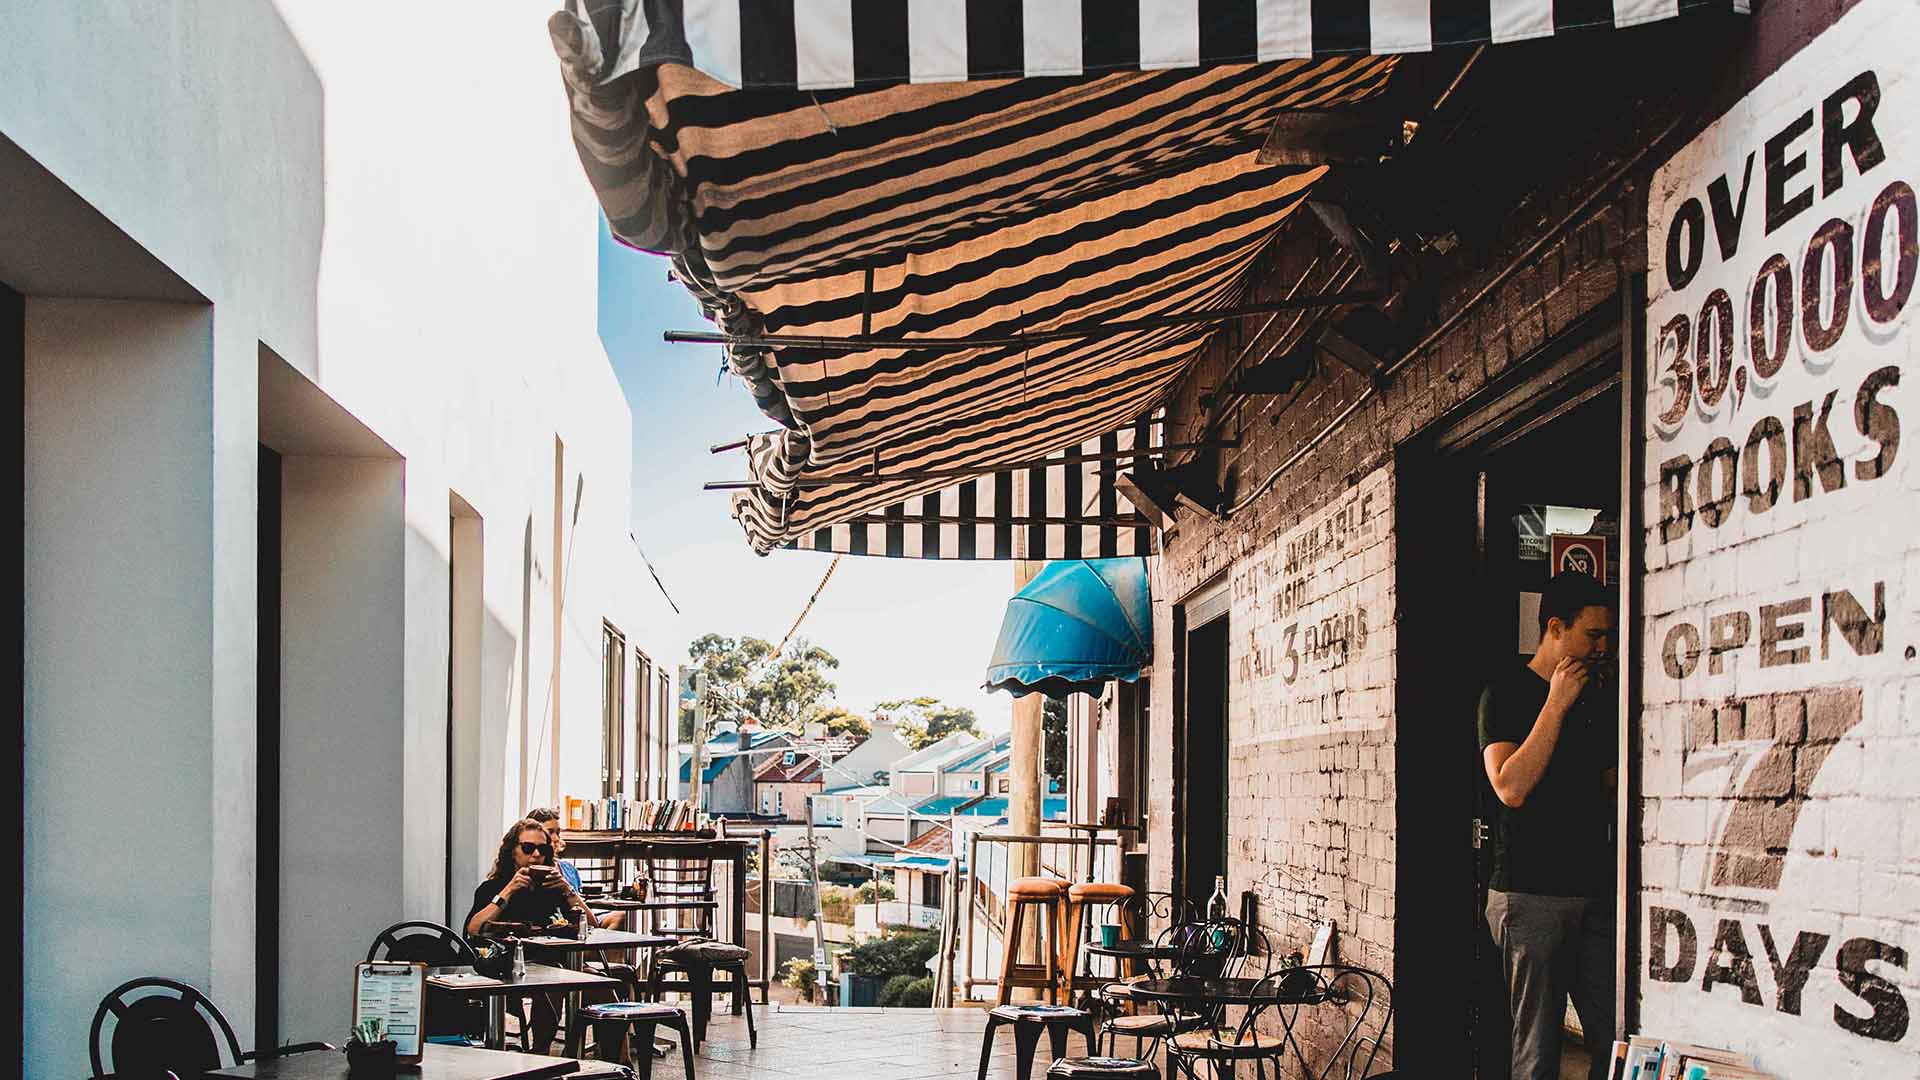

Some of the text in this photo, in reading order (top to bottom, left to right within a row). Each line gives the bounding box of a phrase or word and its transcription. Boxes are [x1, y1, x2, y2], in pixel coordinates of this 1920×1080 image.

[1665, 69, 1886, 291] OVER
[1656, 180, 1919, 428] 30,000
[1658, 365, 1900, 546] BOOKS
[1281, 622, 1299, 686] 3
[1661, 581, 1886, 680] OPEN
[1691, 686, 1864, 891] 7
[1648, 905, 1909, 1043] DAYS
